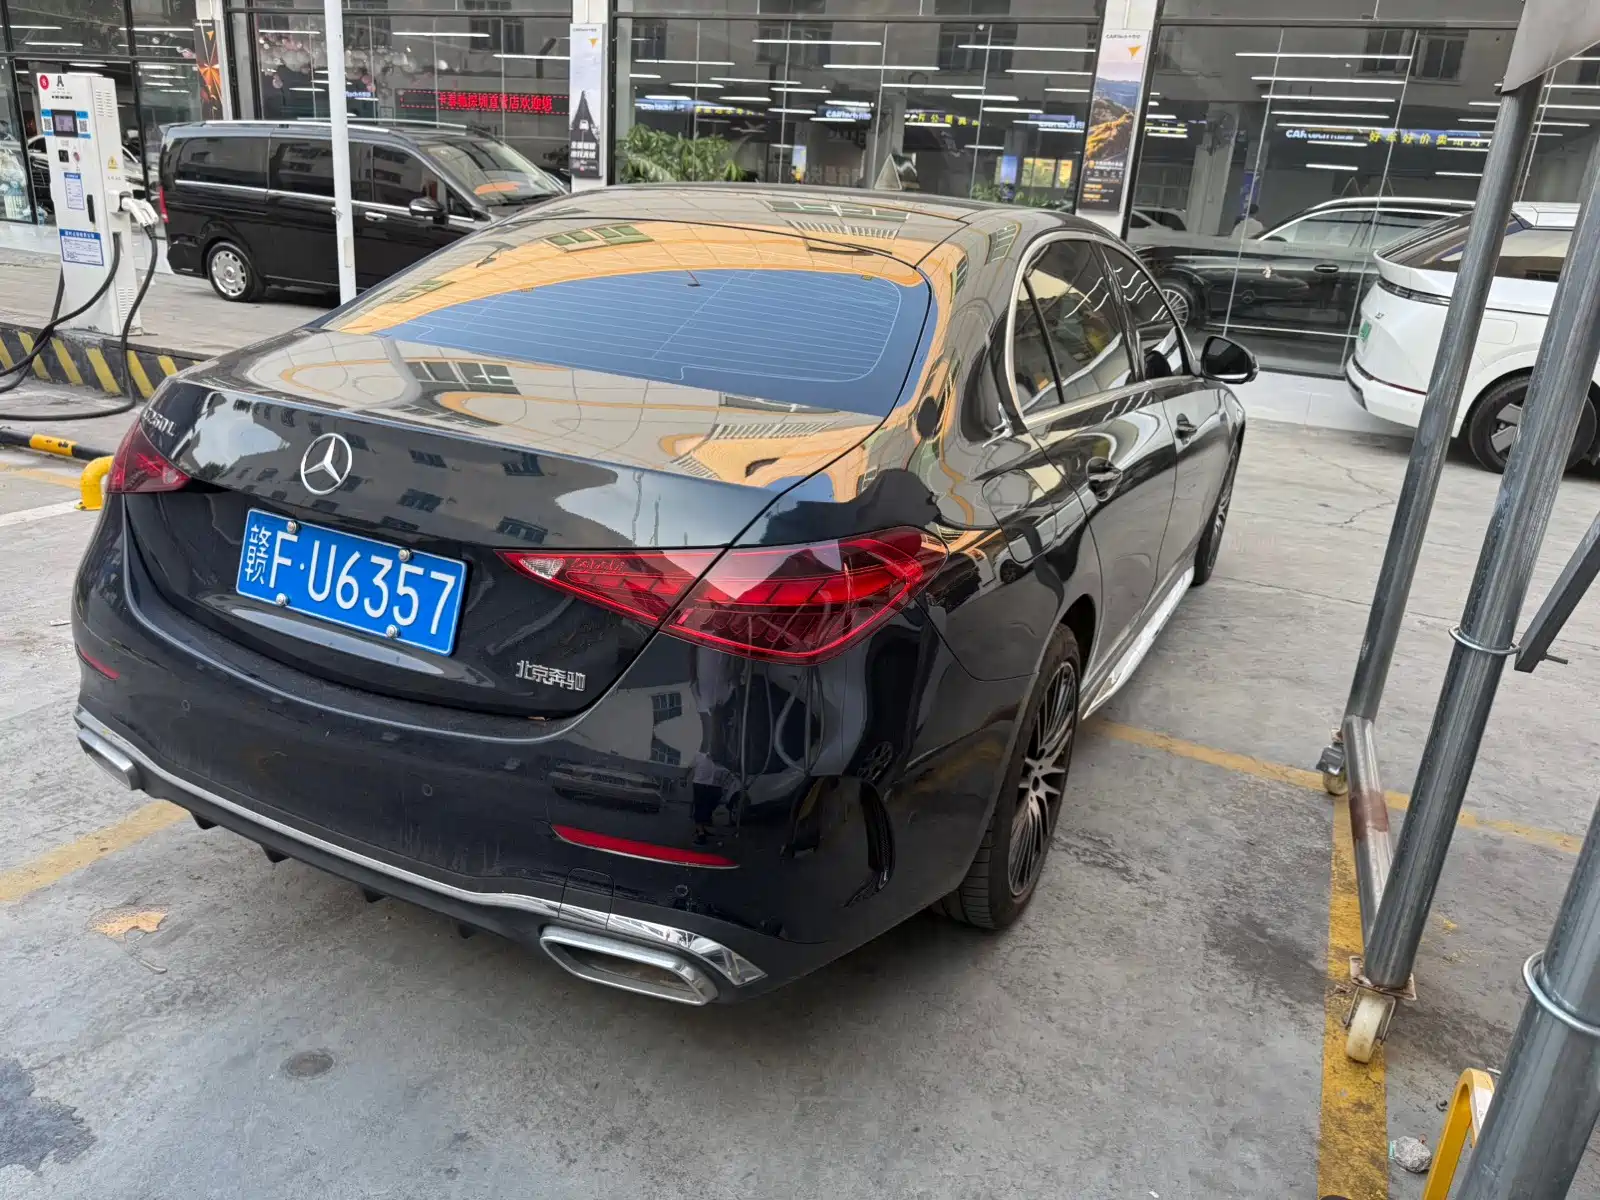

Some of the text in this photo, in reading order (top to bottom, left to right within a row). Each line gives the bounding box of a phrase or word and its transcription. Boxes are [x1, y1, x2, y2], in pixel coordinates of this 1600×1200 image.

[244, 524, 456, 635] 赣F·U6357
[515, 660, 586, 691] 北京奔驰
